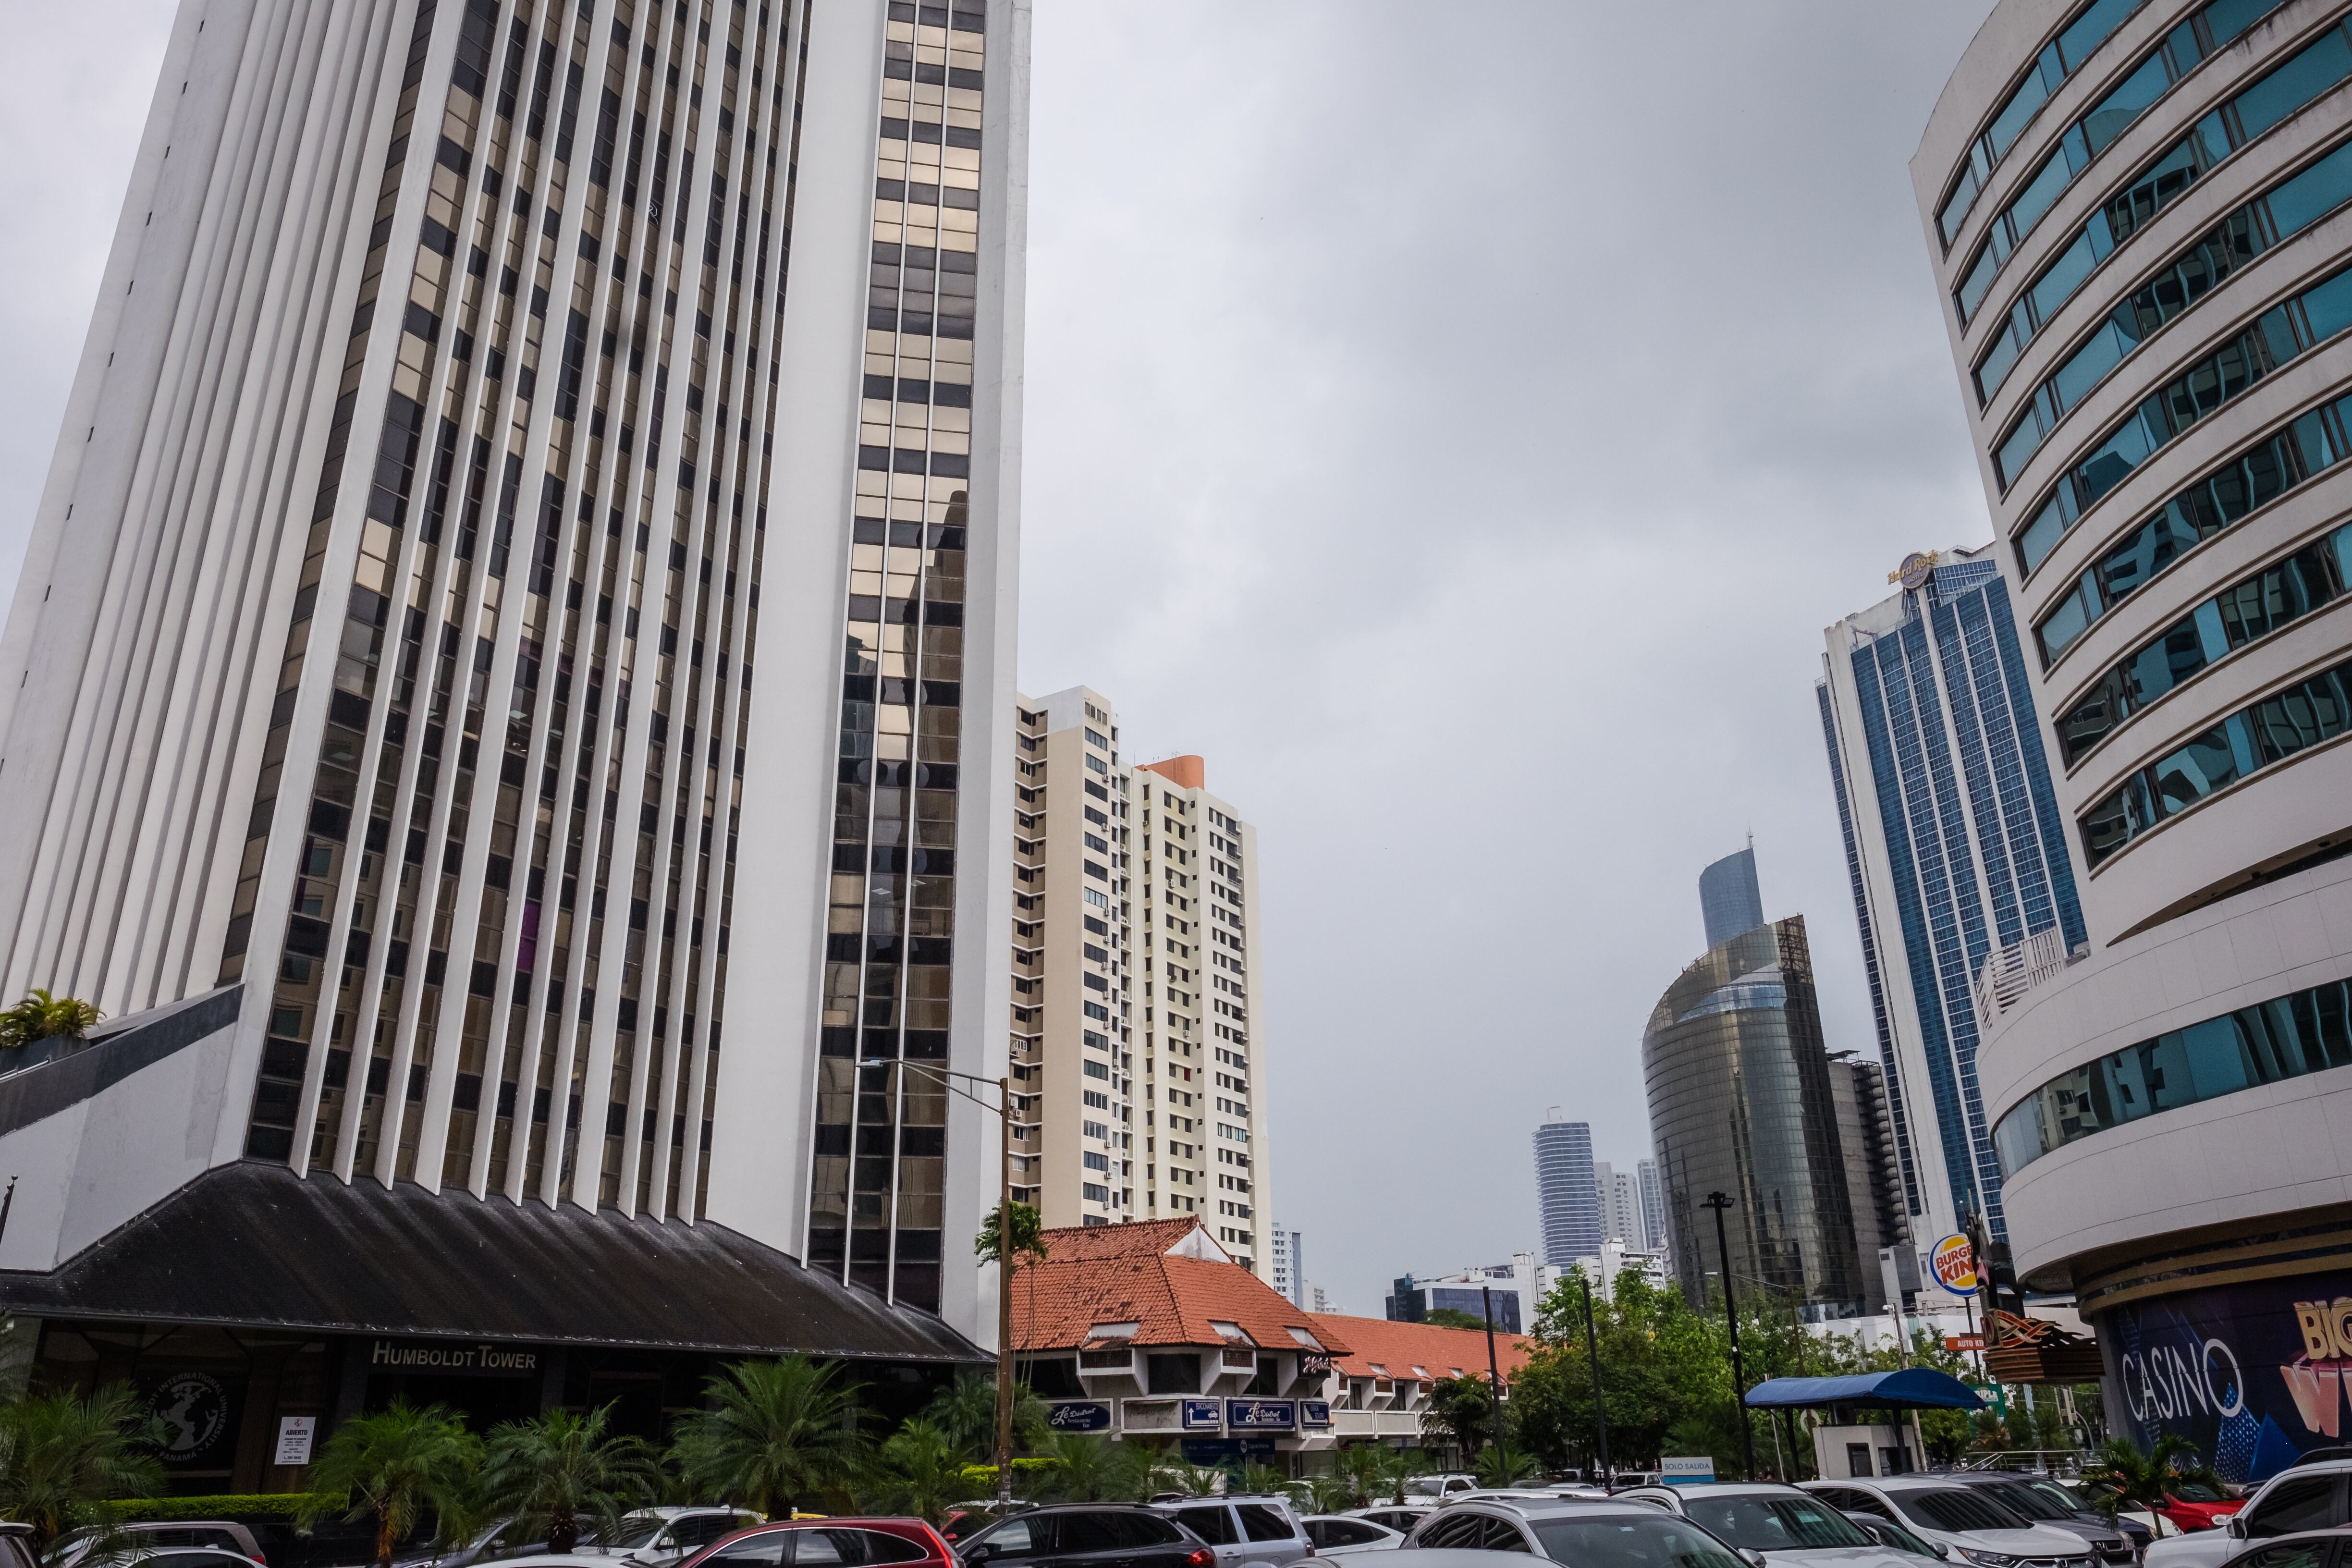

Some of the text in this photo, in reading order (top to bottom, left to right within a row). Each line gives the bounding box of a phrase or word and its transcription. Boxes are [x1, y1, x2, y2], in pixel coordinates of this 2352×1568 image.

[1887, 550, 1939, 585] Hard Rock
[1908, 574, 1923, 584] HOTEL
[1936, 1245, 1972, 1269] BURGE
[1940, 1257, 1974, 1285] KIN
[2123, 1338, 2243, 1421] CASINO
[158, 1372, 223, 1395] INTERNATIONAL
[205, 1395, 227, 1449] UNIVERSITY
[1051, 1406, 1070, 1425] Le
[1246, 1402, 1260, 1424] Le
